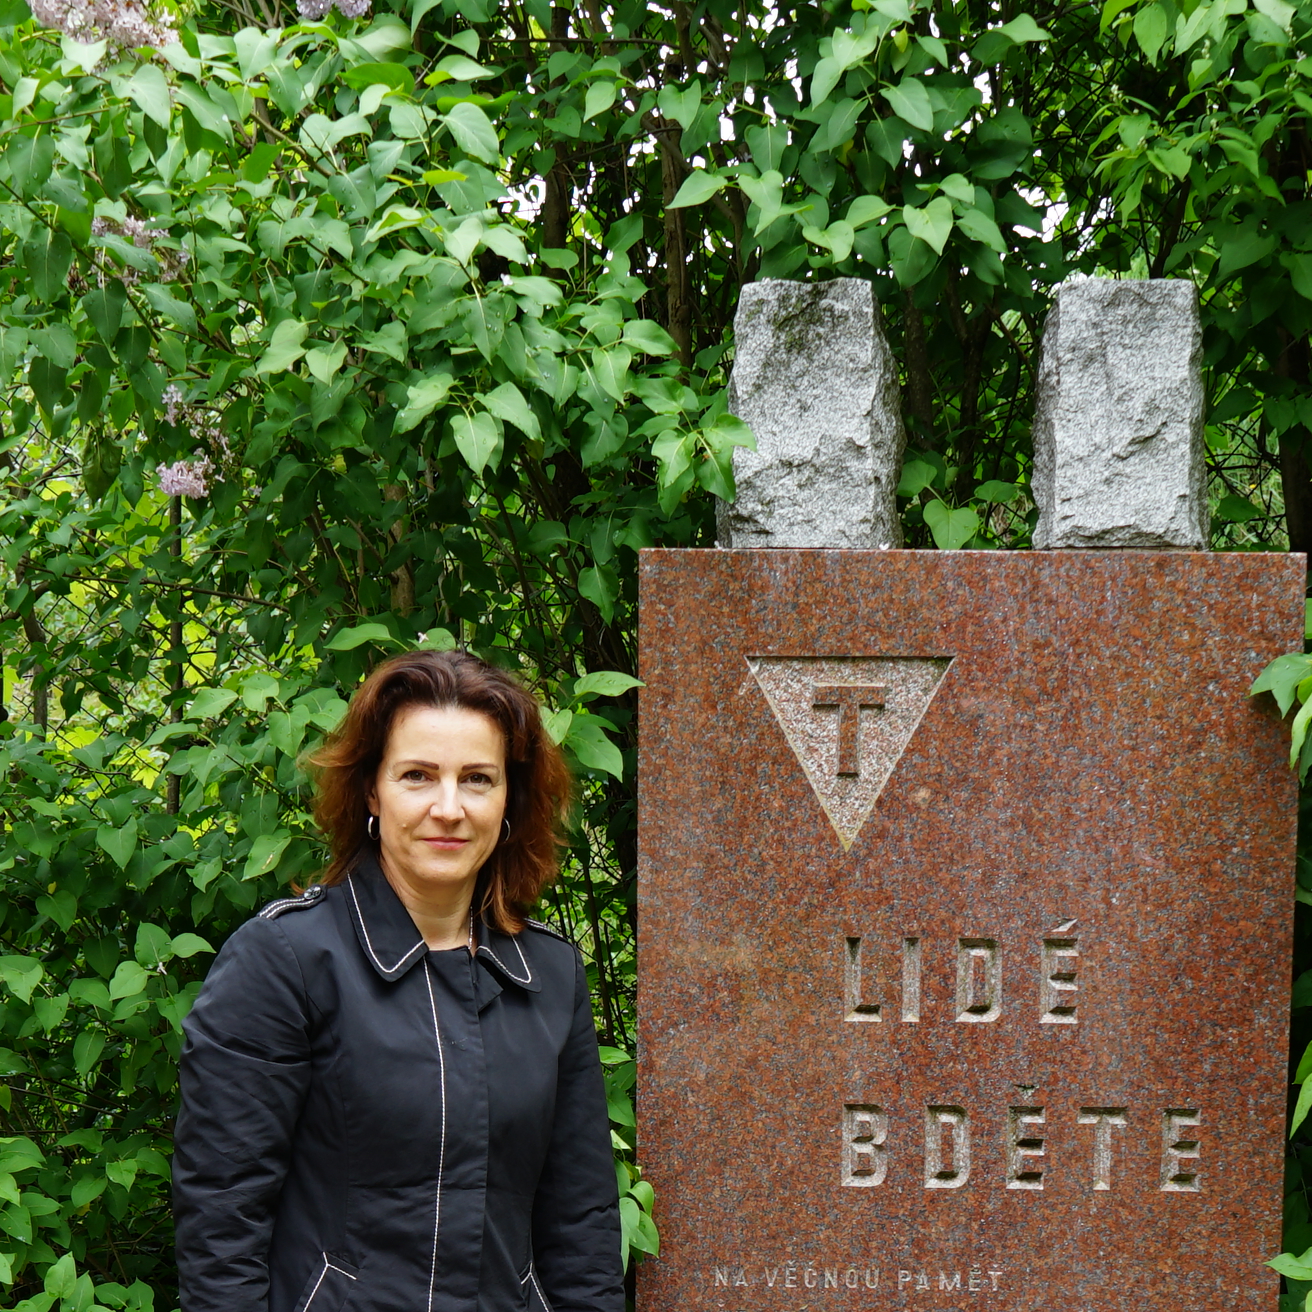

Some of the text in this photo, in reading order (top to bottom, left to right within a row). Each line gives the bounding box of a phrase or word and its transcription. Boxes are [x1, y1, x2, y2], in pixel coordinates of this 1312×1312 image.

[812, 682, 887, 778] T
[843, 918, 1079, 1025] LIDÉ
[841, 1083, 1201, 1192] BDĚTE
[714, 1265, 749, 1288] NA
[764, 1261, 880, 1289] VĚČNOU
